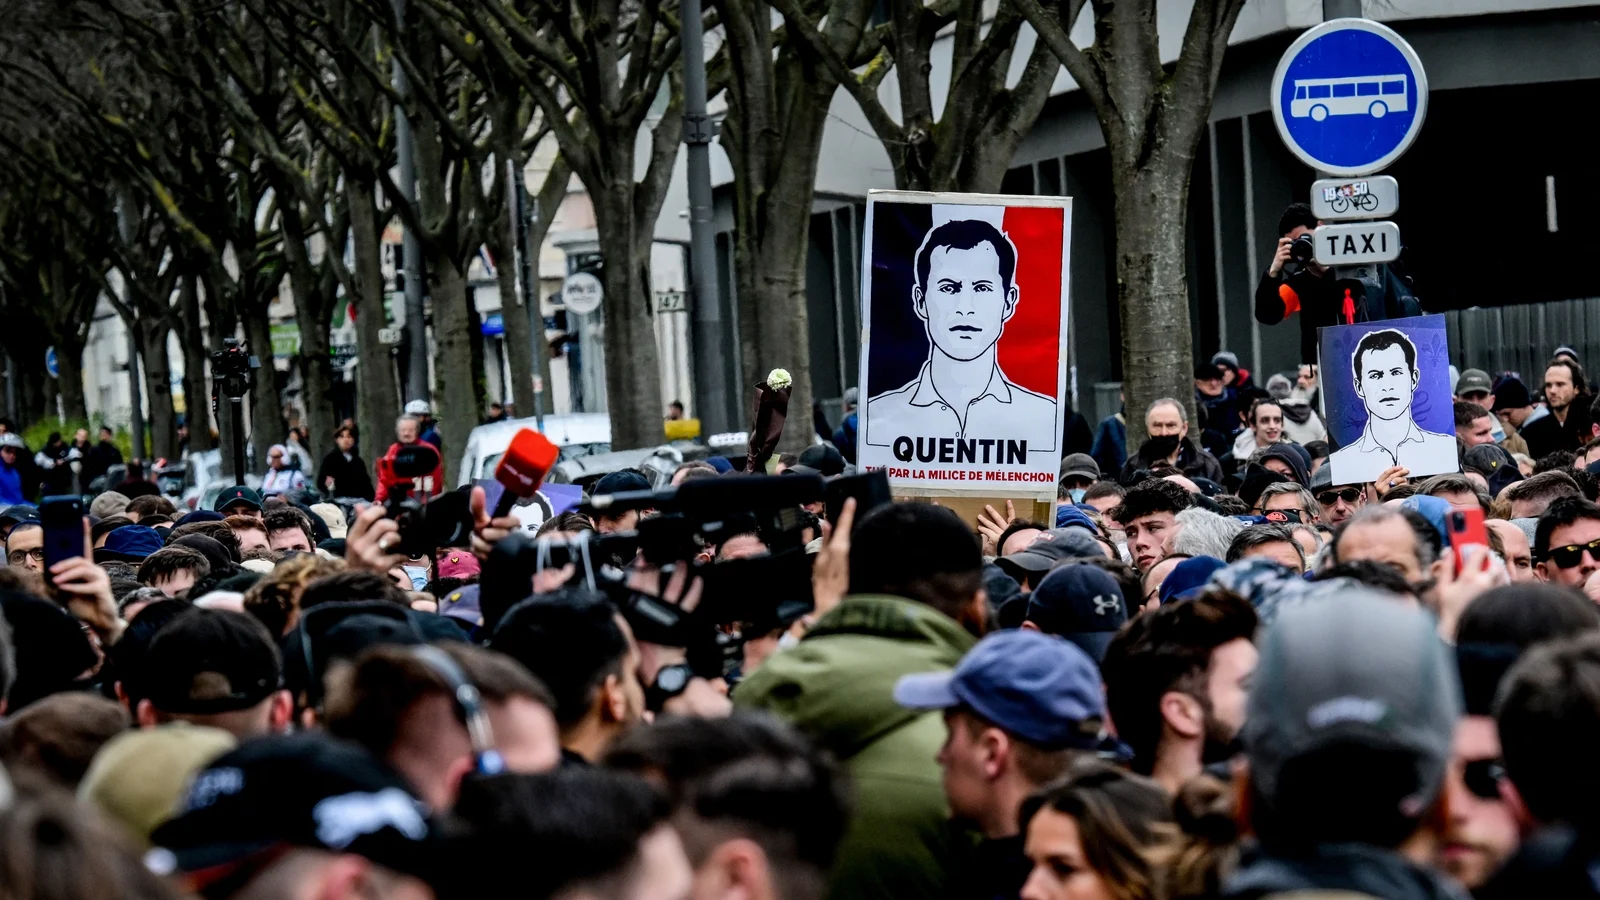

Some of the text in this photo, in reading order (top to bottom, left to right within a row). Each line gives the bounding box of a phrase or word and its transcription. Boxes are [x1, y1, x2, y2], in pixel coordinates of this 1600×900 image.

[1327, 233, 1387, 256] TAXI
[893, 436, 1028, 465] QUENTIN
[889, 467, 910, 478] PAR
[912, 469, 926, 479] LA
[928, 470, 966, 480] MILICE
[968, 471, 983, 481] DE
[985, 469, 1054, 483] MÉLENCHON
